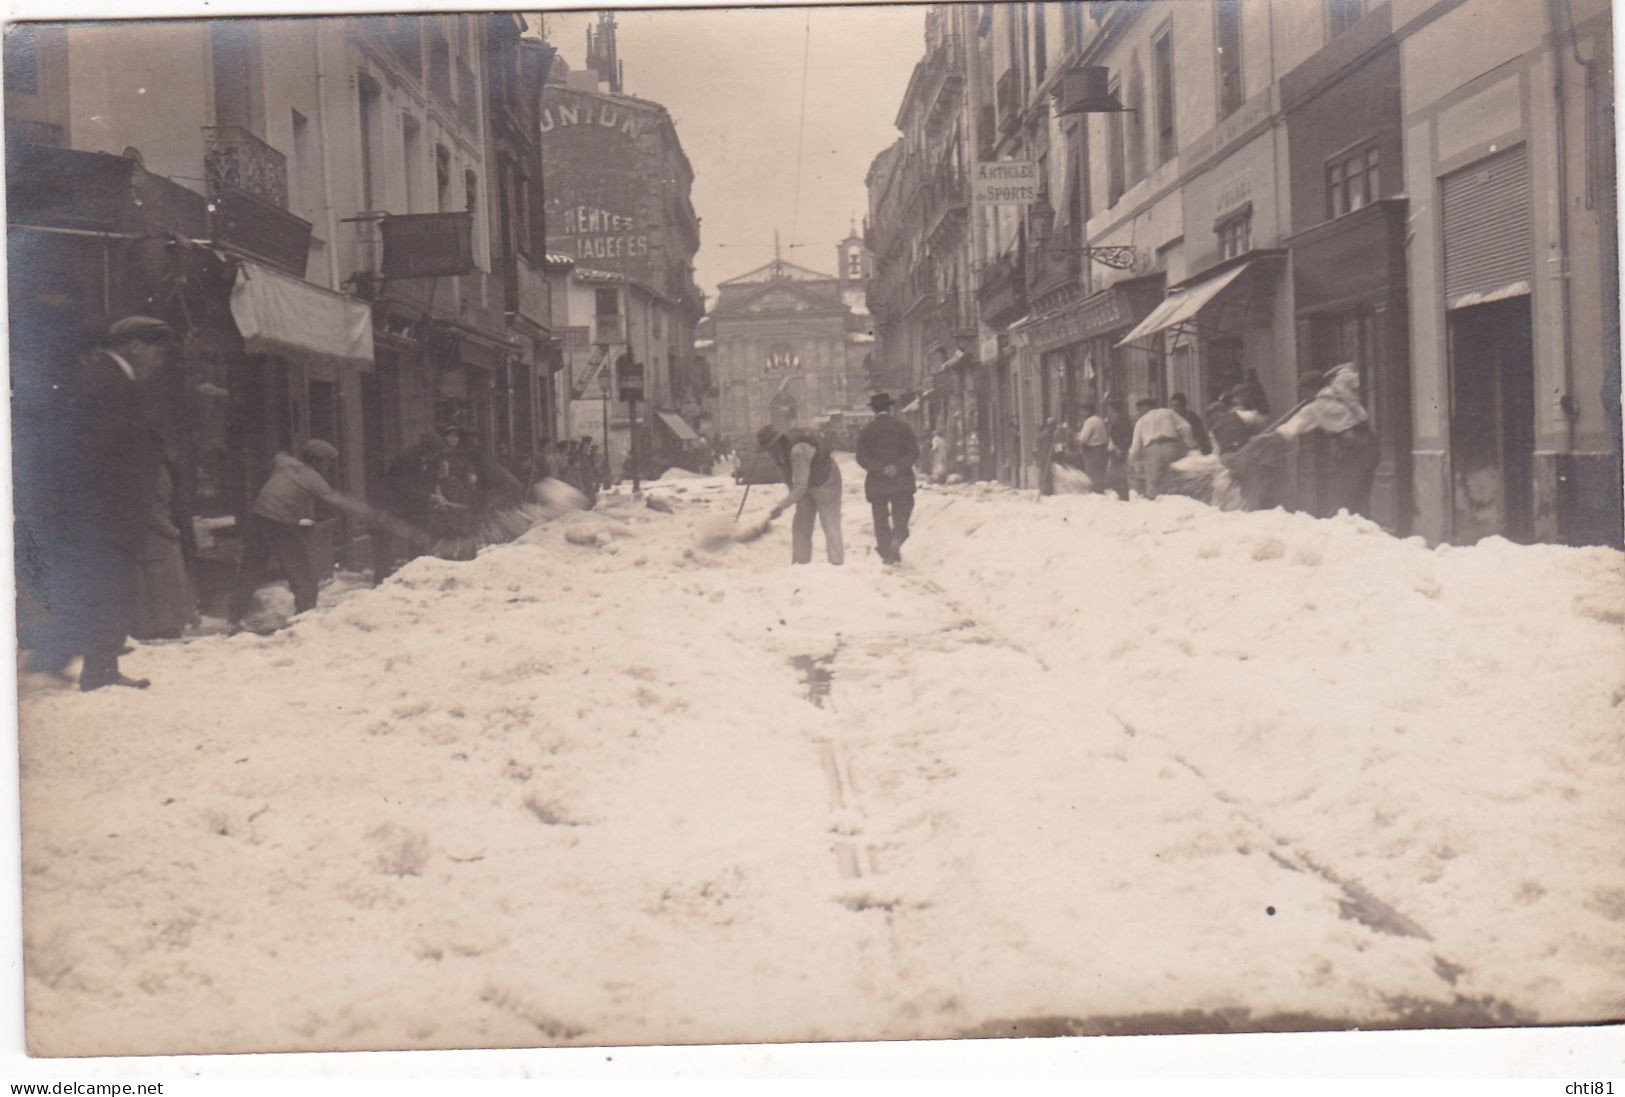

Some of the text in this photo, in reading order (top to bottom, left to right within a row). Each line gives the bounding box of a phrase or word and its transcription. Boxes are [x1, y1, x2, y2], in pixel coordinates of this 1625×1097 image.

[540, 105, 643, 139] UNION
[977, 165, 1034, 180] ARTICLES
[987, 186, 1034, 201] SPORTS
